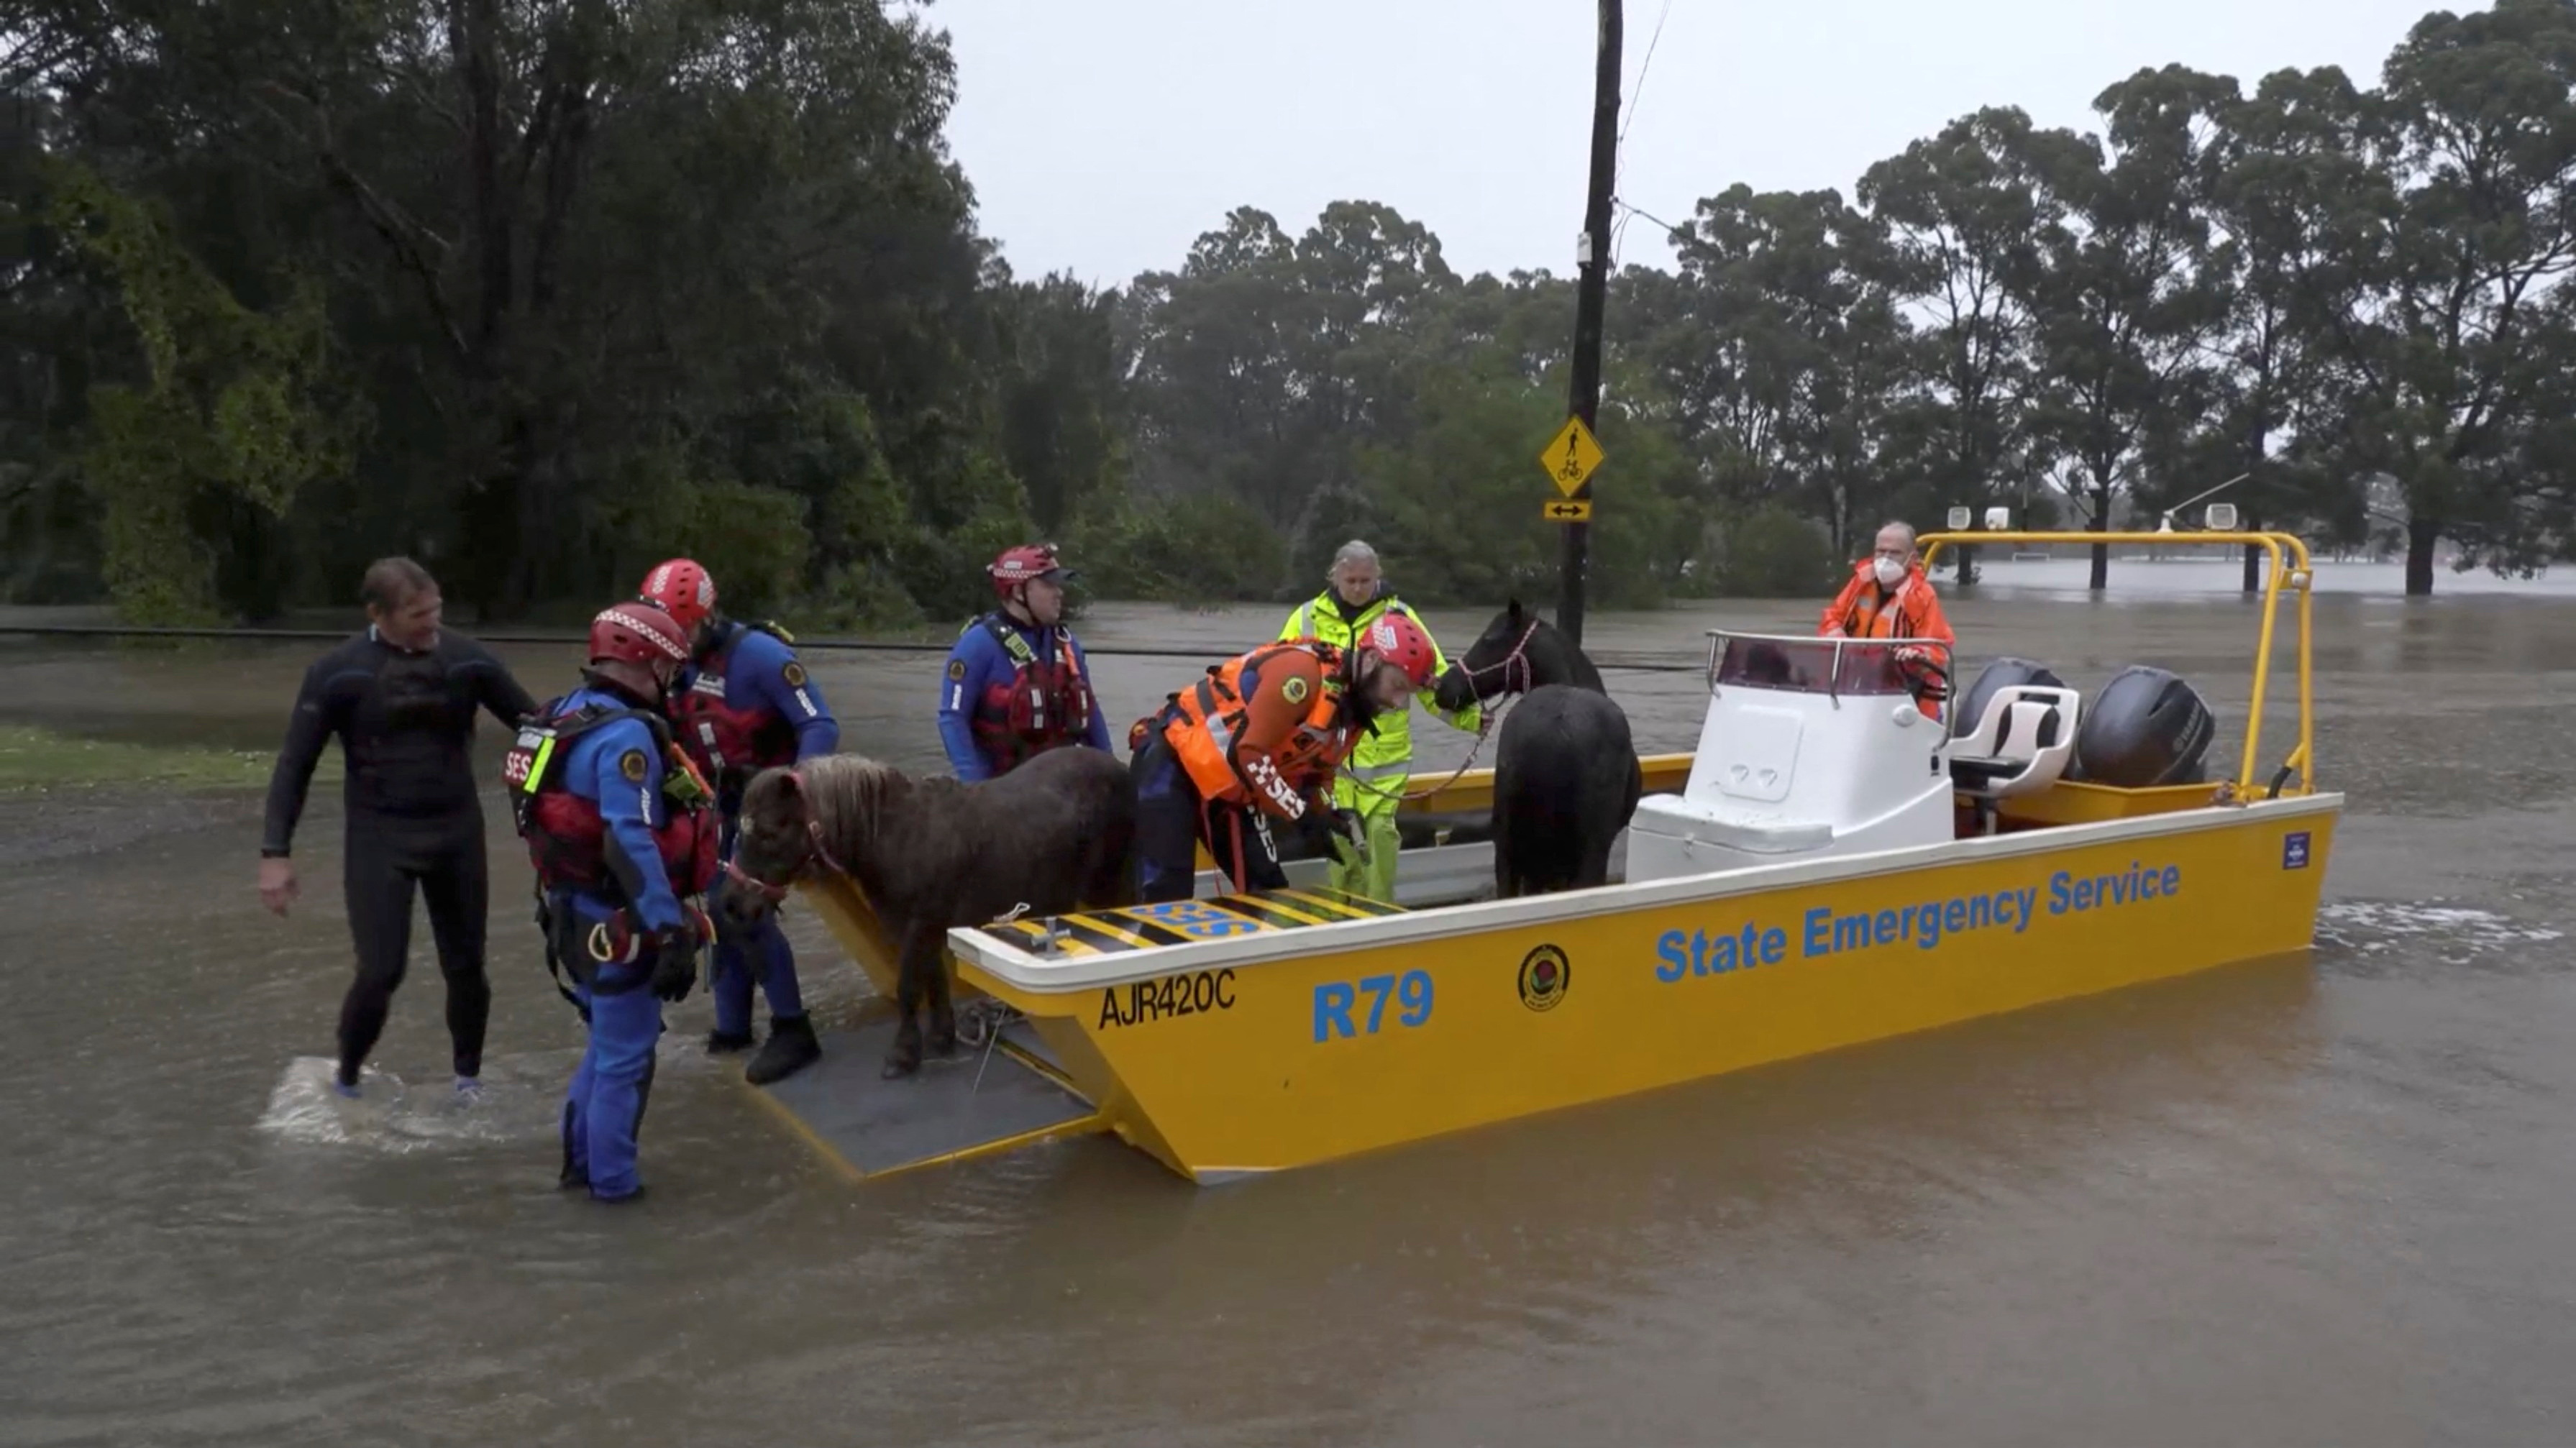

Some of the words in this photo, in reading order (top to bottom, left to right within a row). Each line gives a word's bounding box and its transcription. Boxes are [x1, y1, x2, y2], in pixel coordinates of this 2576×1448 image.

[506, 751, 531, 782] SES
[1266, 776, 1307, 820] SES
[1655, 922, 1787, 983] State
[1803, 886, 2037, 958] Emergency
[2048, 860, 2180, 915] Service
[1098, 968, 1236, 1030] AJR420C
[1313, 969, 1434, 1043] R79
